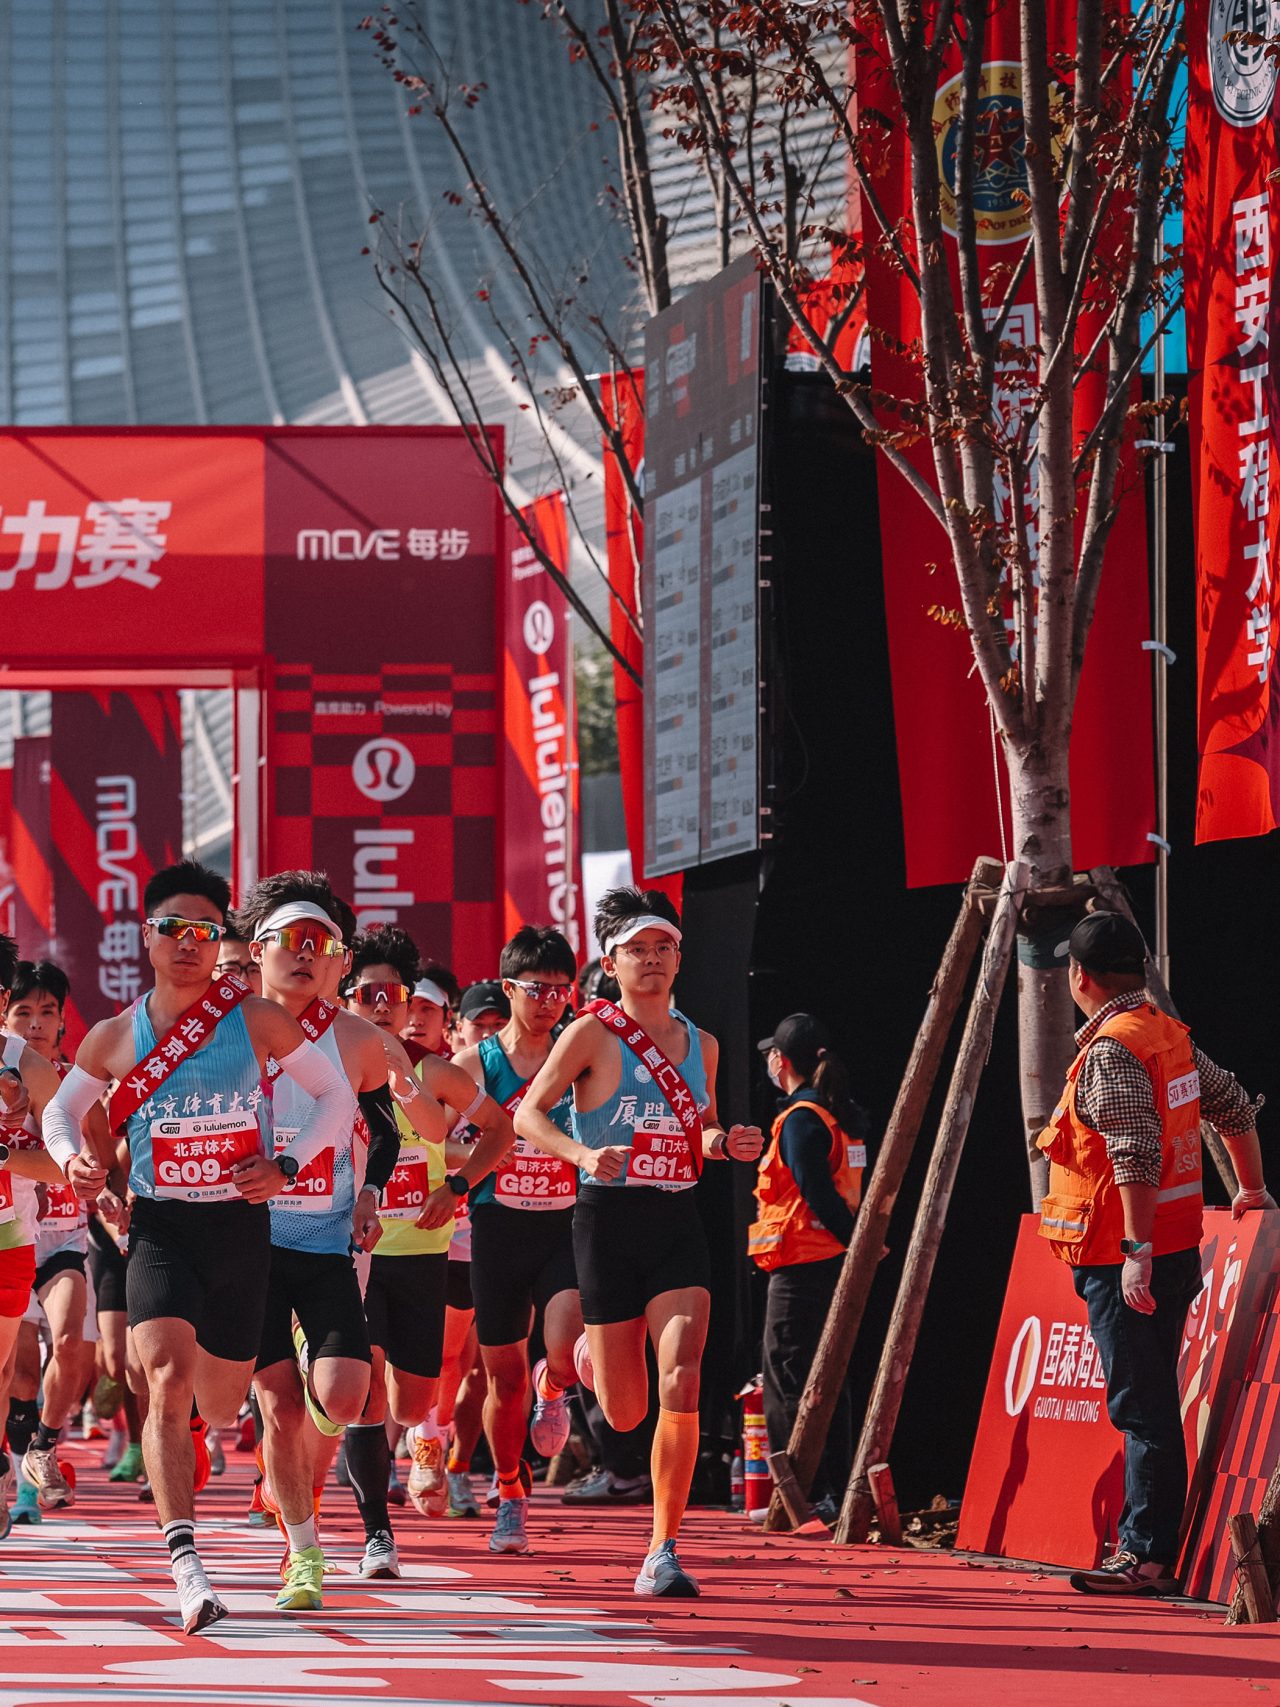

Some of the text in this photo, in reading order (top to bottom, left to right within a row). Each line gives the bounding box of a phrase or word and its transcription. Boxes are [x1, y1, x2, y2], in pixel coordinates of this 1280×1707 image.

[297, 528, 470, 561] MOVE 每步
[96, 774, 138, 912] MOVE
[201, 999, 223, 1018] G09
[301, 1018, 319, 1038] G89
[126, 1018, 205, 1099] 北京体大
[627, 1029, 646, 1045] G61
[642, 1045, 697, 1129] 厦门大学
[139, 1084, 264, 1119] 北京体育大学
[203, 1118, 247, 1133] lululemon
[173, 1137, 236, 1158] 北京体大
[158, 1158, 231, 1185] G09-
[515, 1159, 563, 1174] 同济大学
[632, 1154, 692, 1179] G61-10
[499, 1173, 572, 1196] G82-10
[1034, 1396, 1101, 1423] GUOTAI HAITONG
